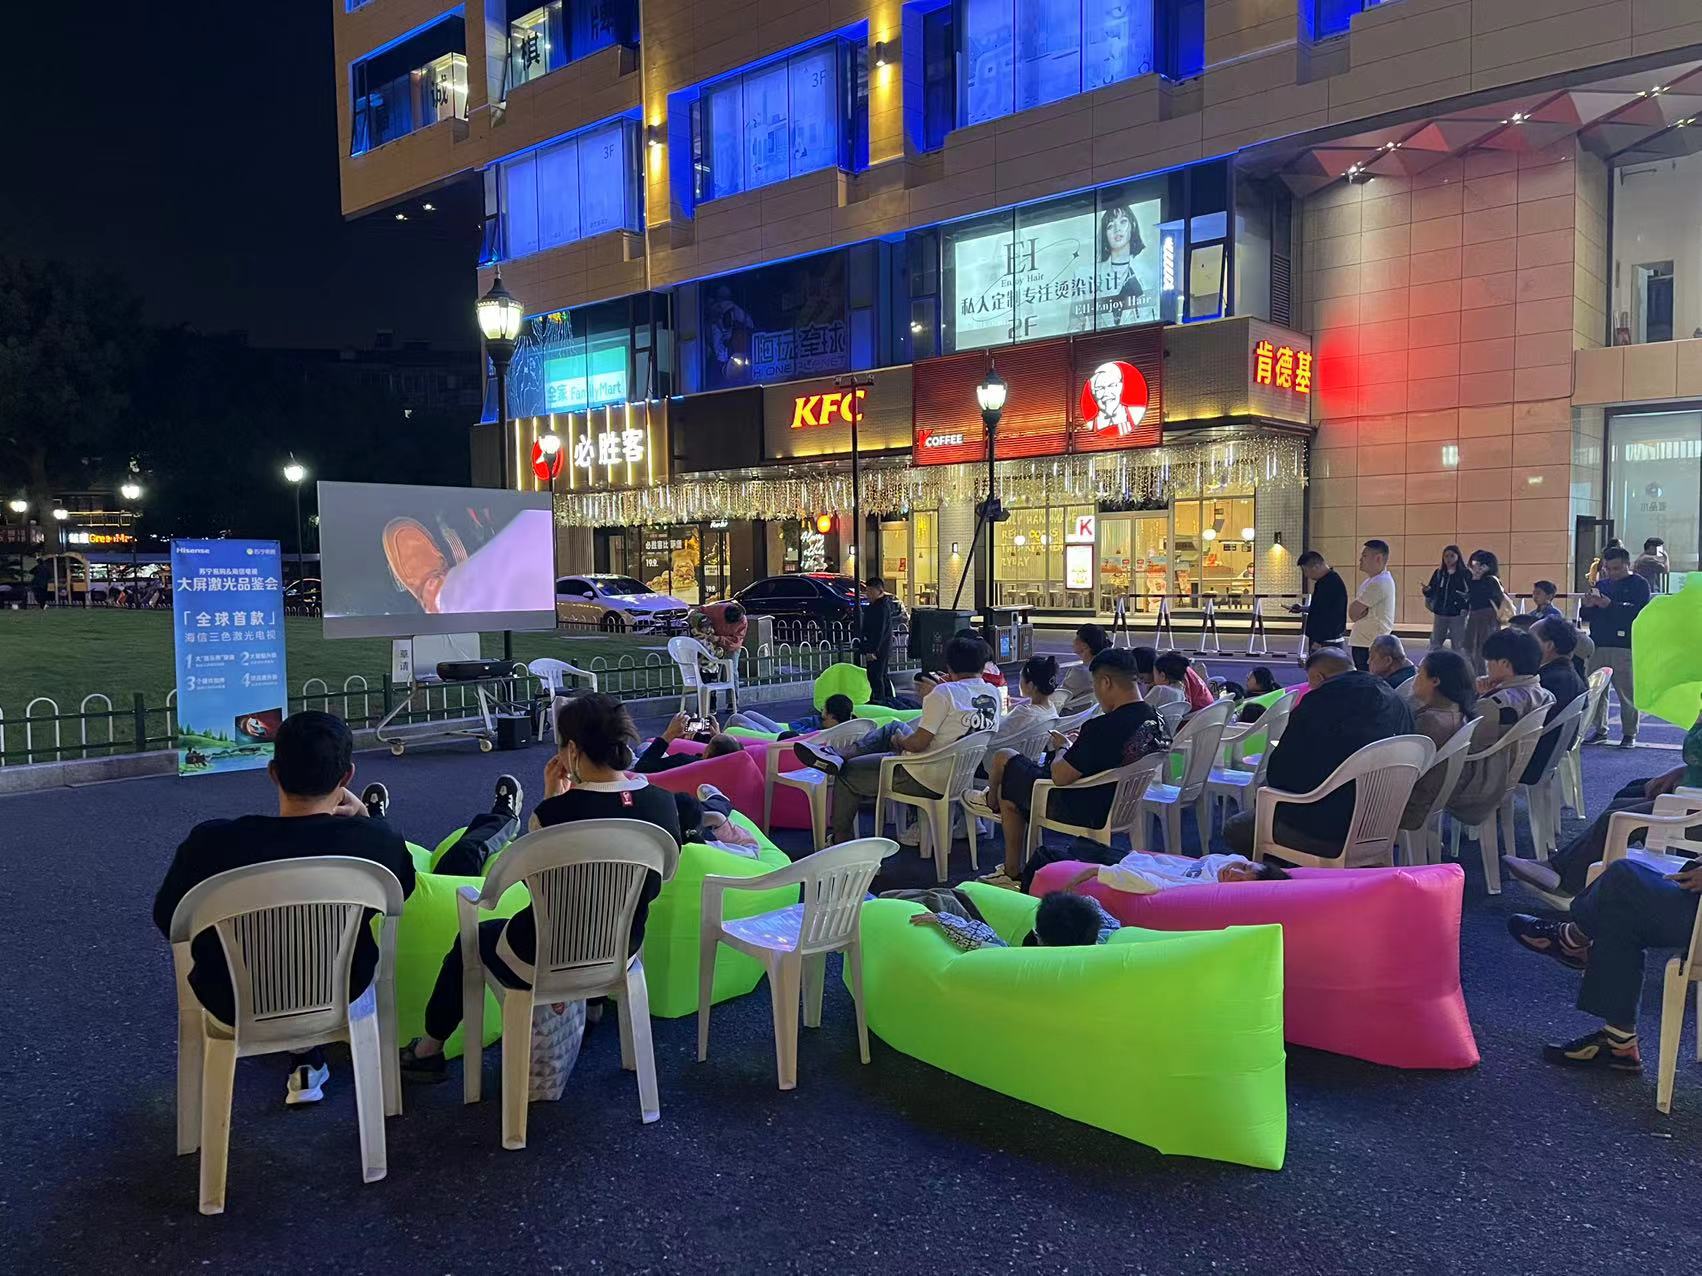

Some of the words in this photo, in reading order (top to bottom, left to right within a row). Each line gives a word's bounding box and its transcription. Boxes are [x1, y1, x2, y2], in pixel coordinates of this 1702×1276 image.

[811, 70, 826, 87] 3F
[602, 144, 615, 160] 3F
[1256, 340, 1312, 394] 肯德基
[548, 384, 568, 403] 全家
[790, 391, 865, 428] KFC
[574, 429, 645, 468] 必胜客
[925, 434, 963, 447] COFFEE
[1080, 519, 1093, 536] K
[177, 577, 278, 592] 大屏激光品鉴会
[184, 630, 277, 643] 海信三色激光电视
[186, 676, 196, 691] 3
[241, 672, 251, 688] 4
